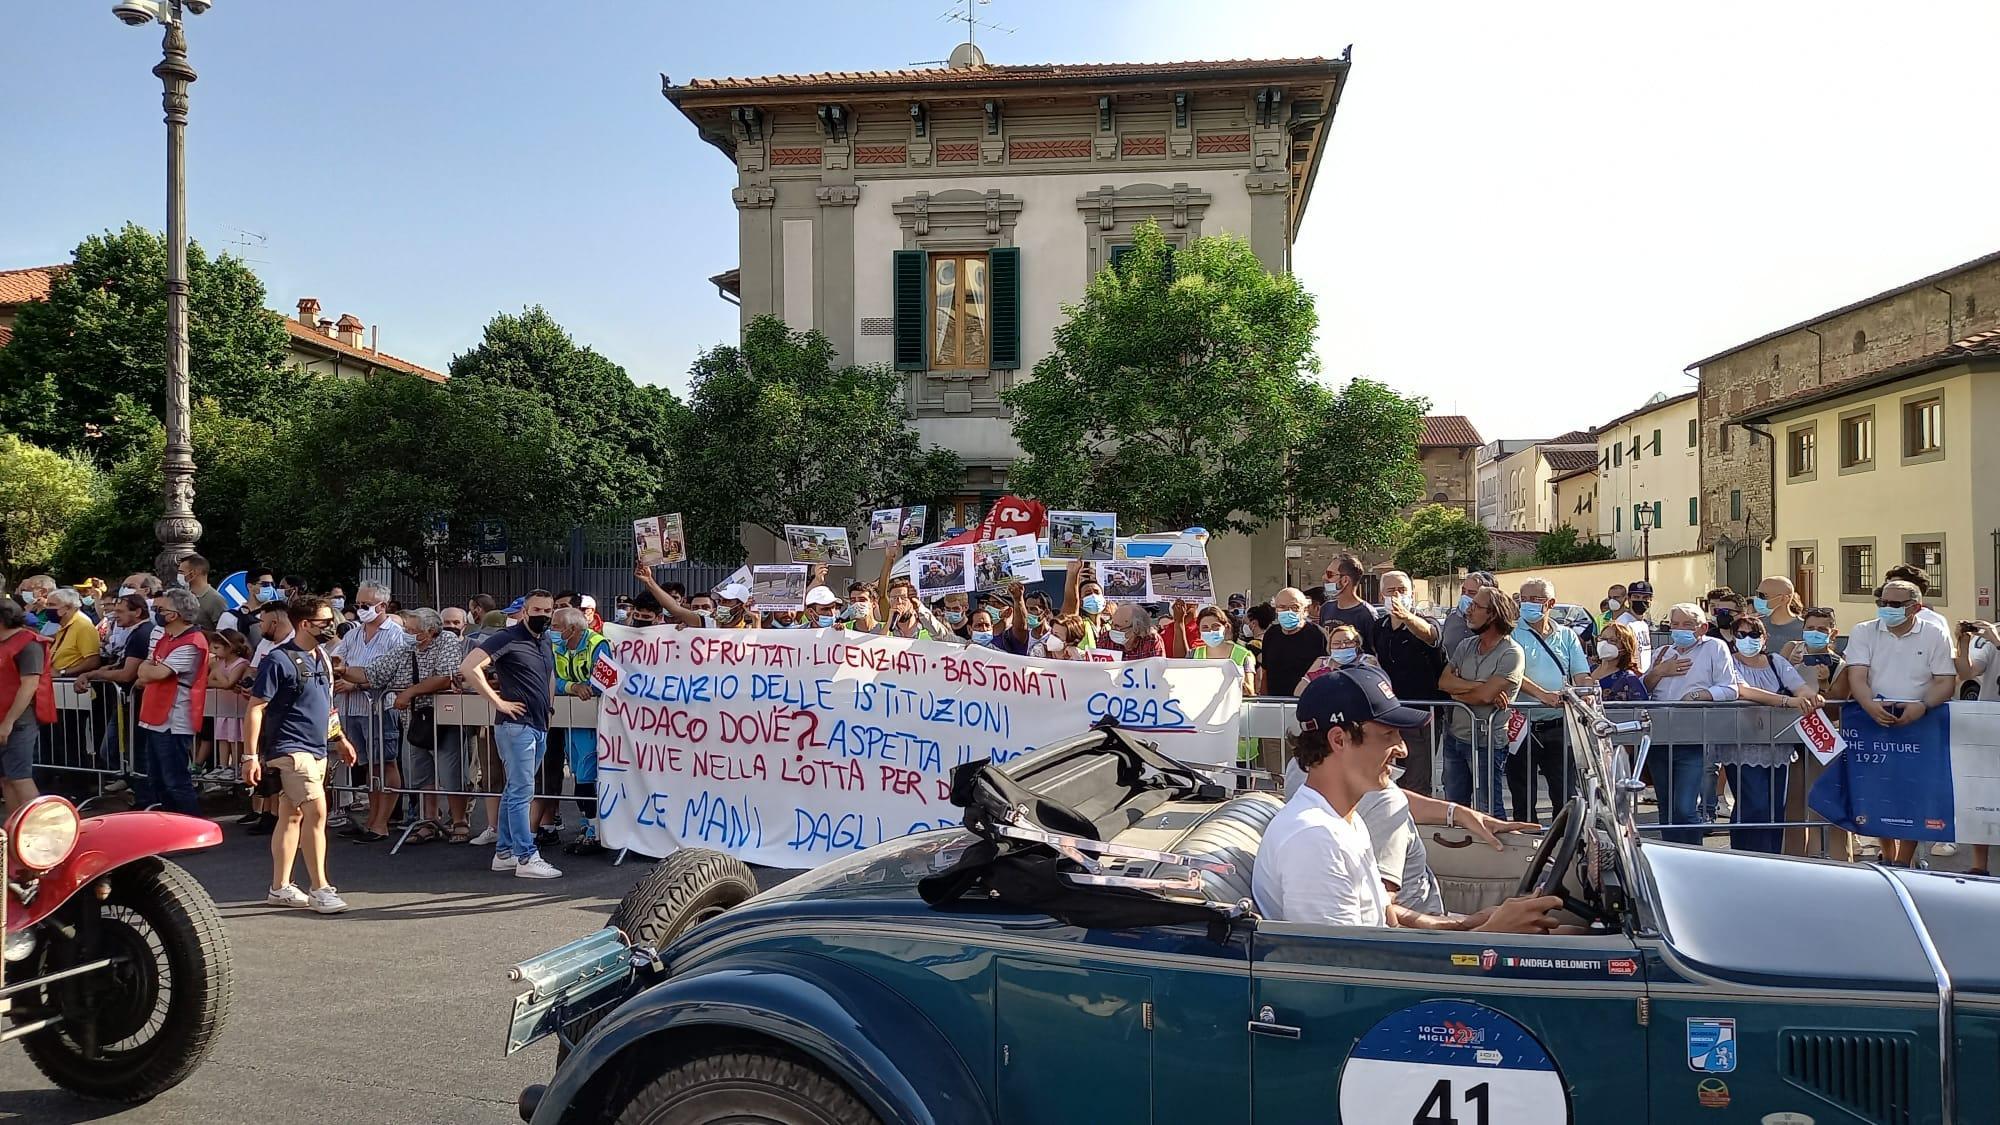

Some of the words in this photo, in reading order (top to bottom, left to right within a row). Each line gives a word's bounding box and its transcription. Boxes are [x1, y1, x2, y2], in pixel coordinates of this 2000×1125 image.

[814, 643, 928, 675] LICENZIATI
[943, 655, 1067, 701] BASTONATI
[1122, 667, 1156, 690] S.I.
[624, 673, 738, 705] SILENZIO
[751, 673, 834, 710] DELLE
[855, 681, 1010, 739] ISTITUZIONI
[1087, 692, 1185, 727] COBAS
[1329, 711, 1345, 724] 41
[1800, 718, 1824, 753] MIGLIA
[1809, 713, 1830, 741] 1000
[1855, 753, 1887, 764] 1927
[1873, 741, 1921, 754] FUTURE
[635, 740, 682, 772] VIVE
[693, 750, 767, 781] NELLA
[781, 758, 865, 791] LOTTA
[880, 765, 927, 805] PER
[637, 792, 668, 829] LE
[681, 790, 762, 850] MANI
[788, 808, 885, 852] DAGLI
[1519, 957, 1553, 969] ANDREA
[1554, 958, 1601, 970] BELOMETTI
[1418, 1026, 1455, 1035] 1000
[1418, 1034, 1456, 1043] MIGLIA
[1412, 1079, 1489, 1125] 41
